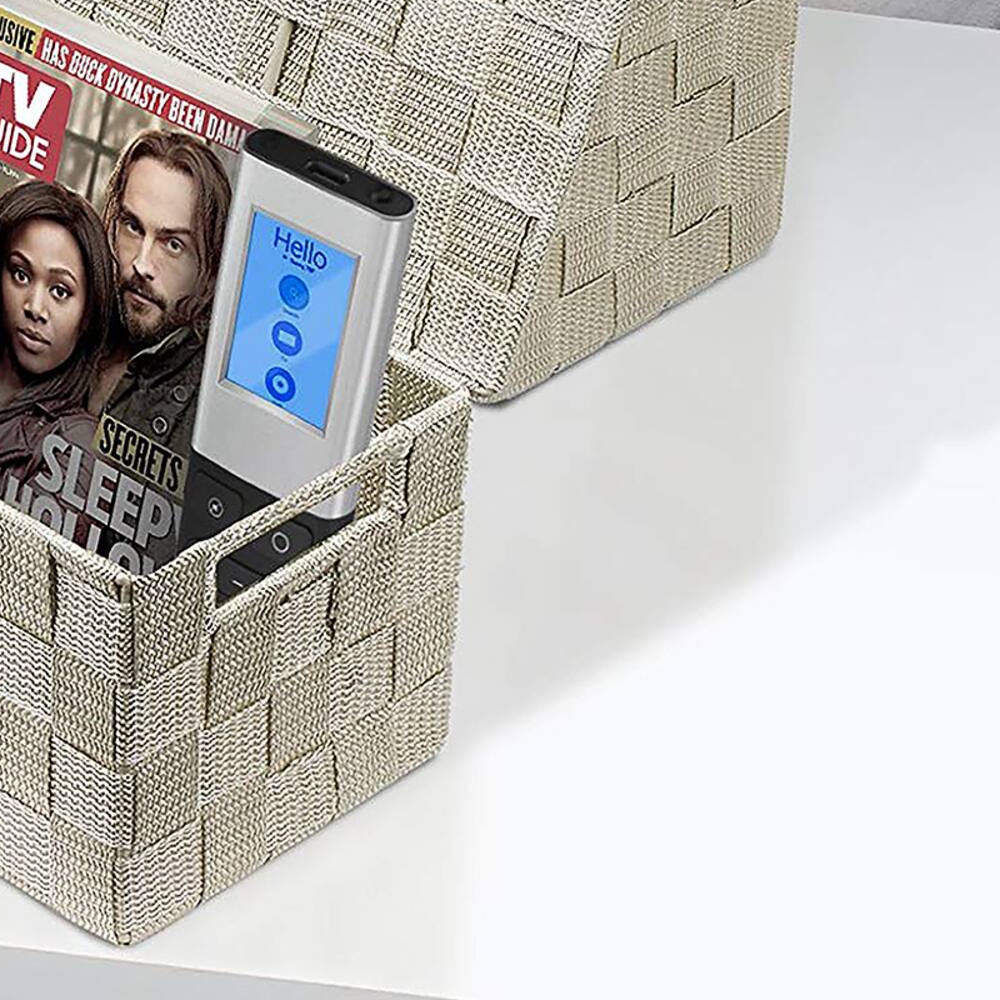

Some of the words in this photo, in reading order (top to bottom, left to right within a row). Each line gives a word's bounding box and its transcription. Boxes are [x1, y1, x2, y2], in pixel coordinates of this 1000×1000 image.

[40, 37, 70, 70] HAS
[68, 50, 108, 87] DUCK
[105, 66, 171, 116] DYNASTY
[168, 96, 206, 136] BEEN
[273, 226, 328, 270] Hello
[100, 417, 183, 493] SECRETS
